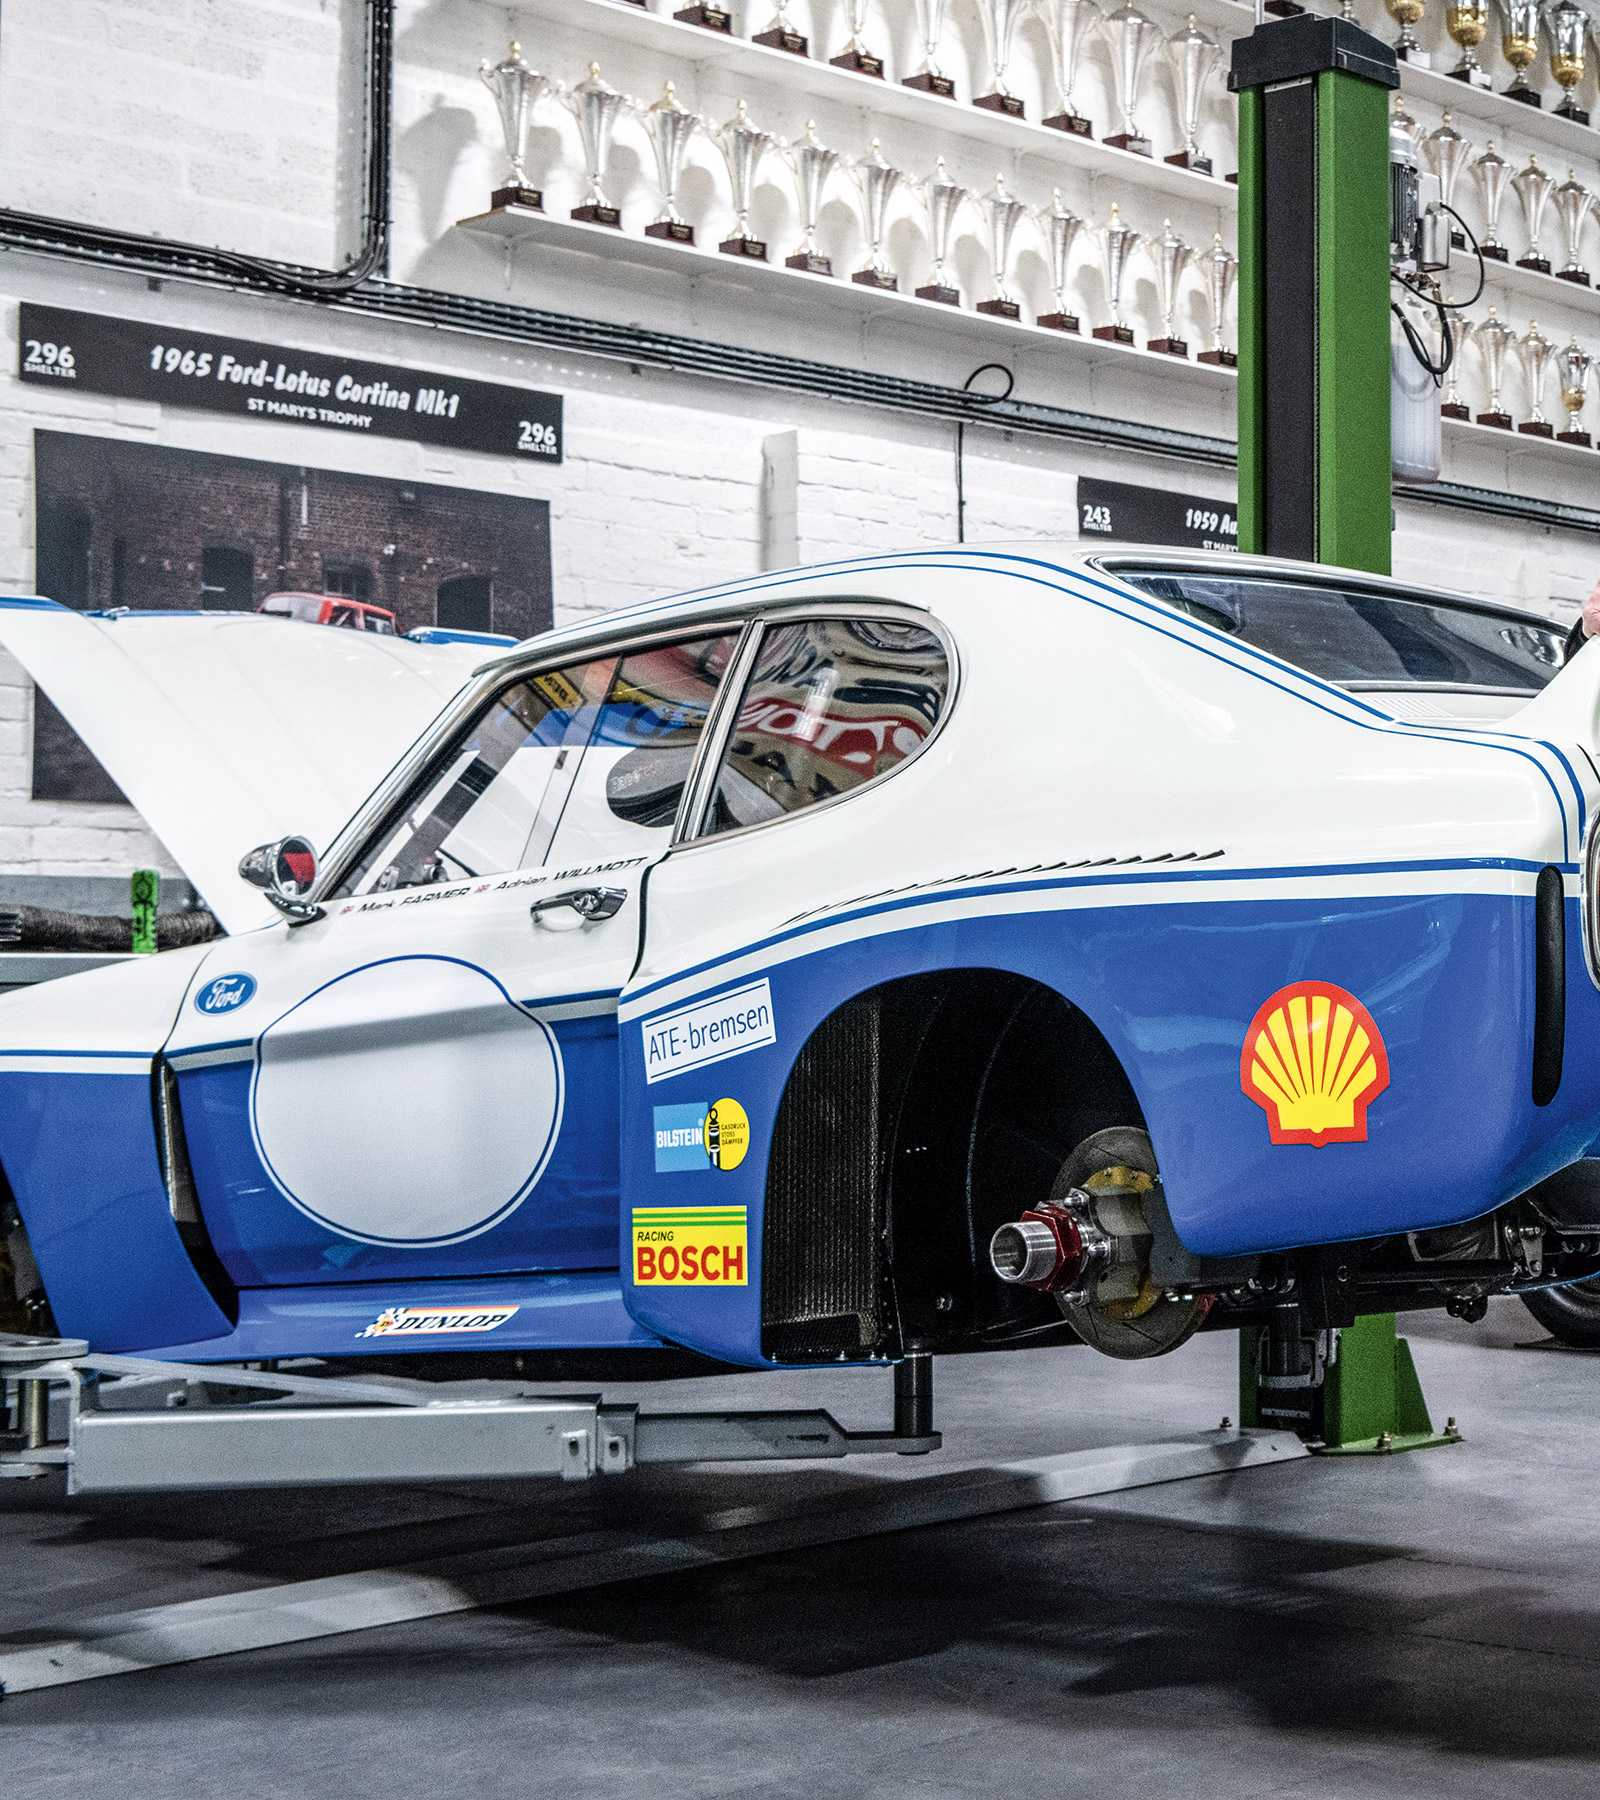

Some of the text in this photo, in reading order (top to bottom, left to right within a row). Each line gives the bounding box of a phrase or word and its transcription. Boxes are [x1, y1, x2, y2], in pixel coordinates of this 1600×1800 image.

[25, 340, 75, 368] 296
[24, 362, 76, 378] SHELTER
[150, 344, 459, 418] 1965 Ford-Lotus Cortina Mk1
[247, 397, 373, 428] ST MARY'S TROPHY
[519, 421, 556, 446] 296
[517, 440, 557, 455] SHELTER
[1083, 504, 1111, 525] 243
[1083, 521, 1112, 532] SHELTER
[1185, 508, 1238, 535] 1959 Au
[400, 887, 471, 906] FARMER
[492, 876, 547, 891] Adrian
[553, 856, 649, 881] WILLMOTT
[205, 978, 246, 1010] Ford
[649, 1004, 769, 1064] ATE-bremsen
[656, 1127, 703, 1148] BILSTEIN
[637, 1231, 675, 1242] RACING
[637, 1245, 743, 1281] BOSCH
[394, 1314, 509, 1330] DUNLOP
